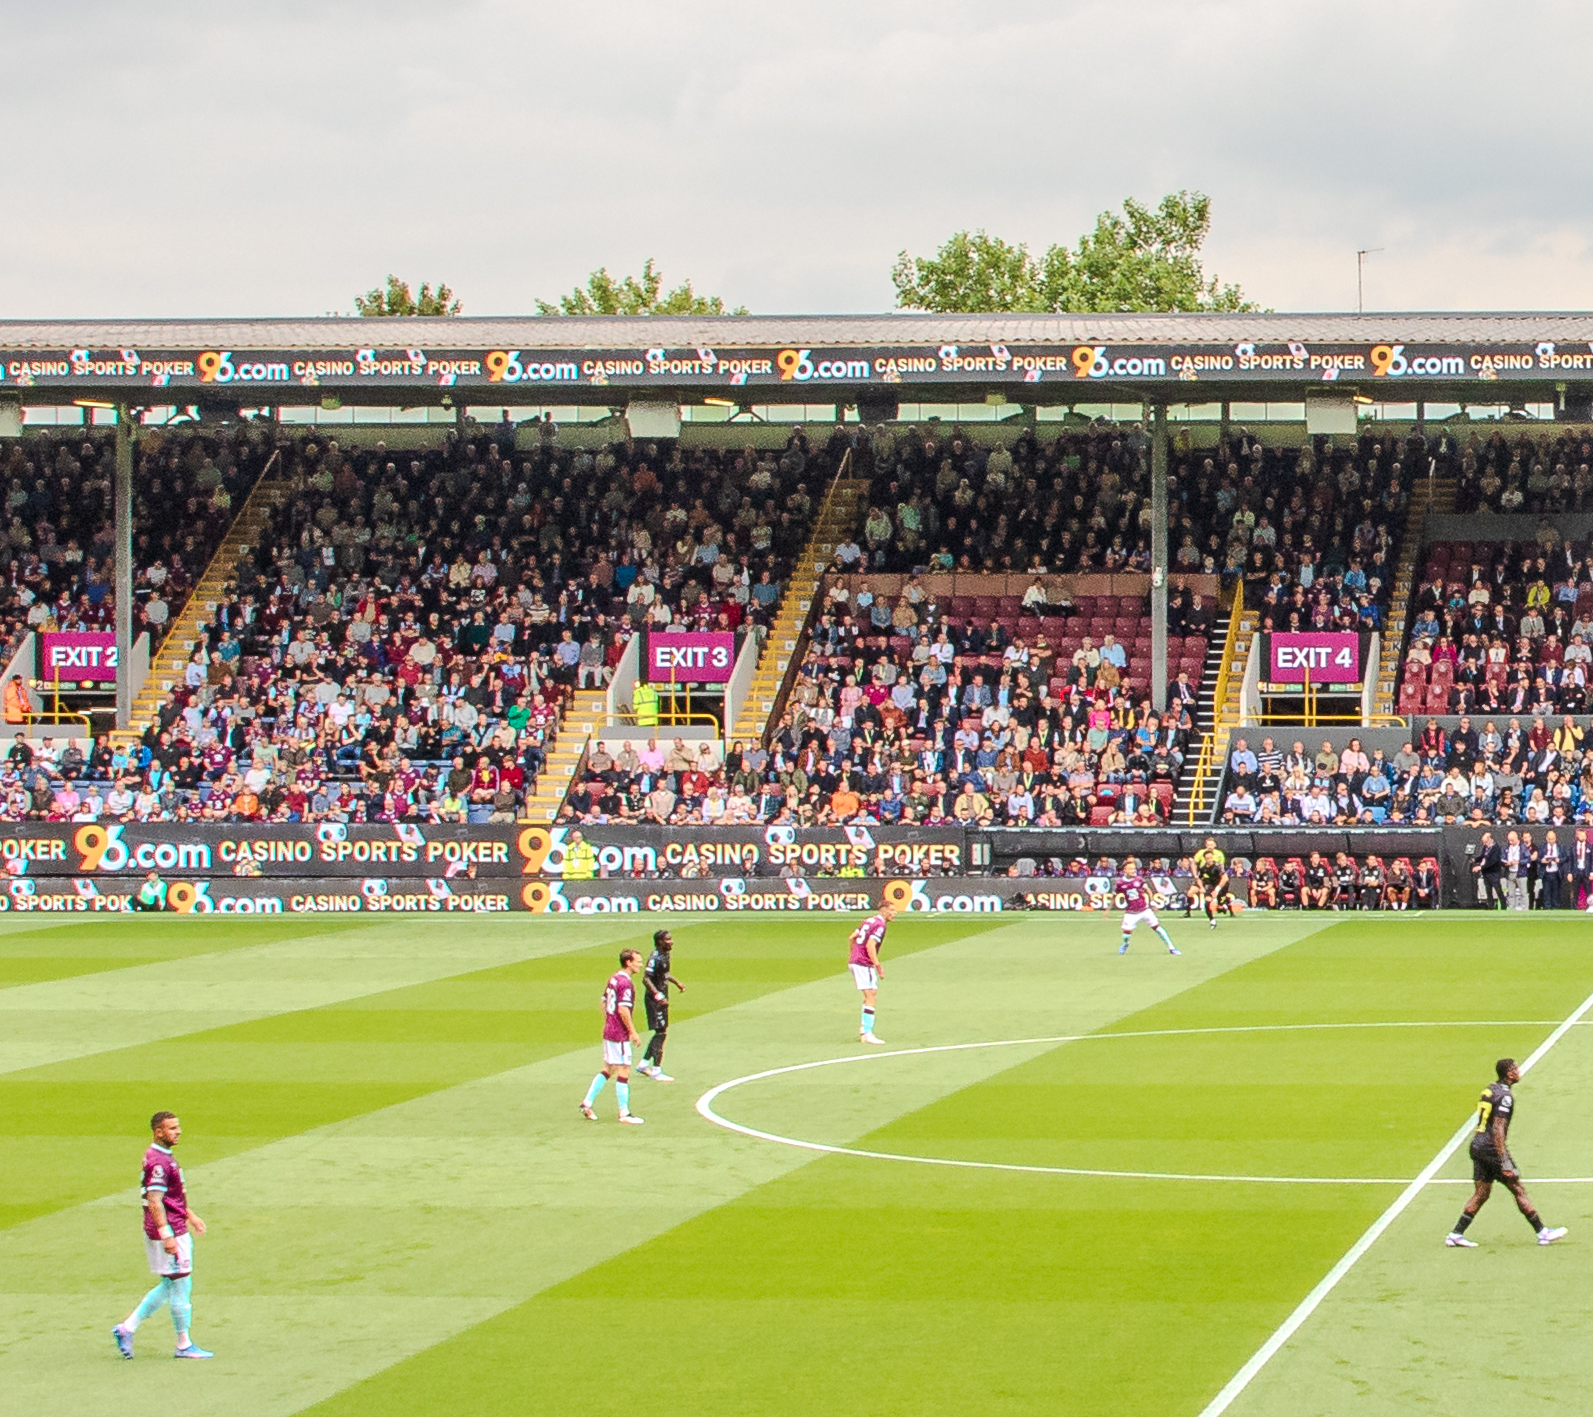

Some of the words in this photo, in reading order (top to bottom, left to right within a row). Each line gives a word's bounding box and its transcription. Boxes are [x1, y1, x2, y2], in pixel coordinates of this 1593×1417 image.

[777, 347, 869, 379] 96.com
[875, 358, 936, 371] CASINO
[942, 357, 1010, 371] SPORTS
[1013, 357, 1066, 371] POKER
[1370, 345, 1464, 377] 96.com
[1470, 356, 1533, 370] CASINO
[51, 646, 100, 667] EXIT
[105, 646, 118, 667] 2
[656, 647, 708, 668] EXIT
[712, 647, 728, 668] 3
[1277, 647, 1331, 668] EXIT
[1335, 647, 1352, 668] 4
[74, 824, 212, 871] 96.com
[218, 840, 312, 864] CASINO
[322, 840, 418, 863] SPORTS
[428, 841, 509, 864] POKER
[167, 880, 284, 914] 96.com
[291, 895, 360, 911] CASINO
